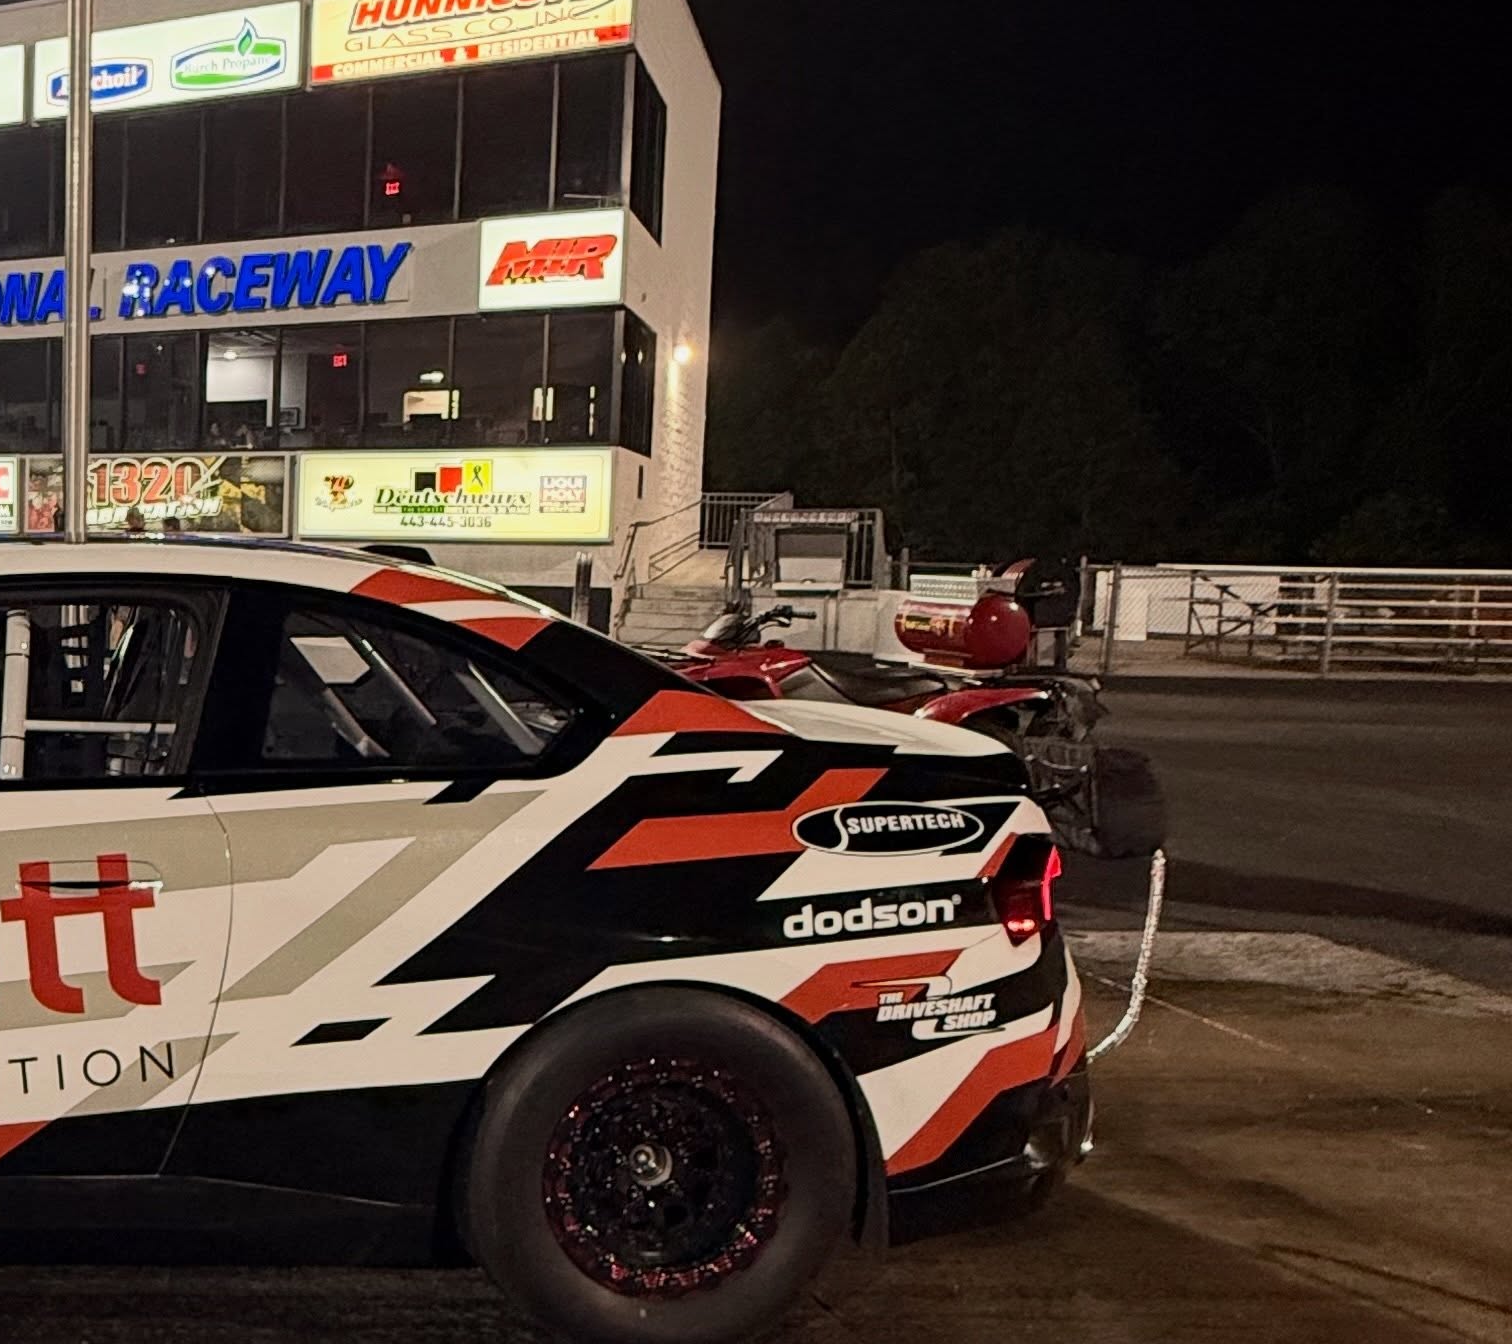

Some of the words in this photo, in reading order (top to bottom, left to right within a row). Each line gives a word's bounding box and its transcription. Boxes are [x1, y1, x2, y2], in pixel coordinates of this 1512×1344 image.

[344, 27, 453, 52] GLASS
[536, 6, 599, 26] INC.
[223, 54, 271, 72] Propane
[332, 50, 444, 77] COMMERCIAL
[454, 46, 468, 61] &
[478, 28, 598, 58] RESIDENTIAL
[485, 234, 618, 286] MIR
[119, 241, 413, 320] RACEWAY
[87, 457, 204, 506] 1320
[846, 812, 966, 835] SUPERTECH
[876, 993, 996, 1022] DRIVESHAFT
[879, 991, 904, 1005] THE
[942, 1009, 997, 1031] SHOP
